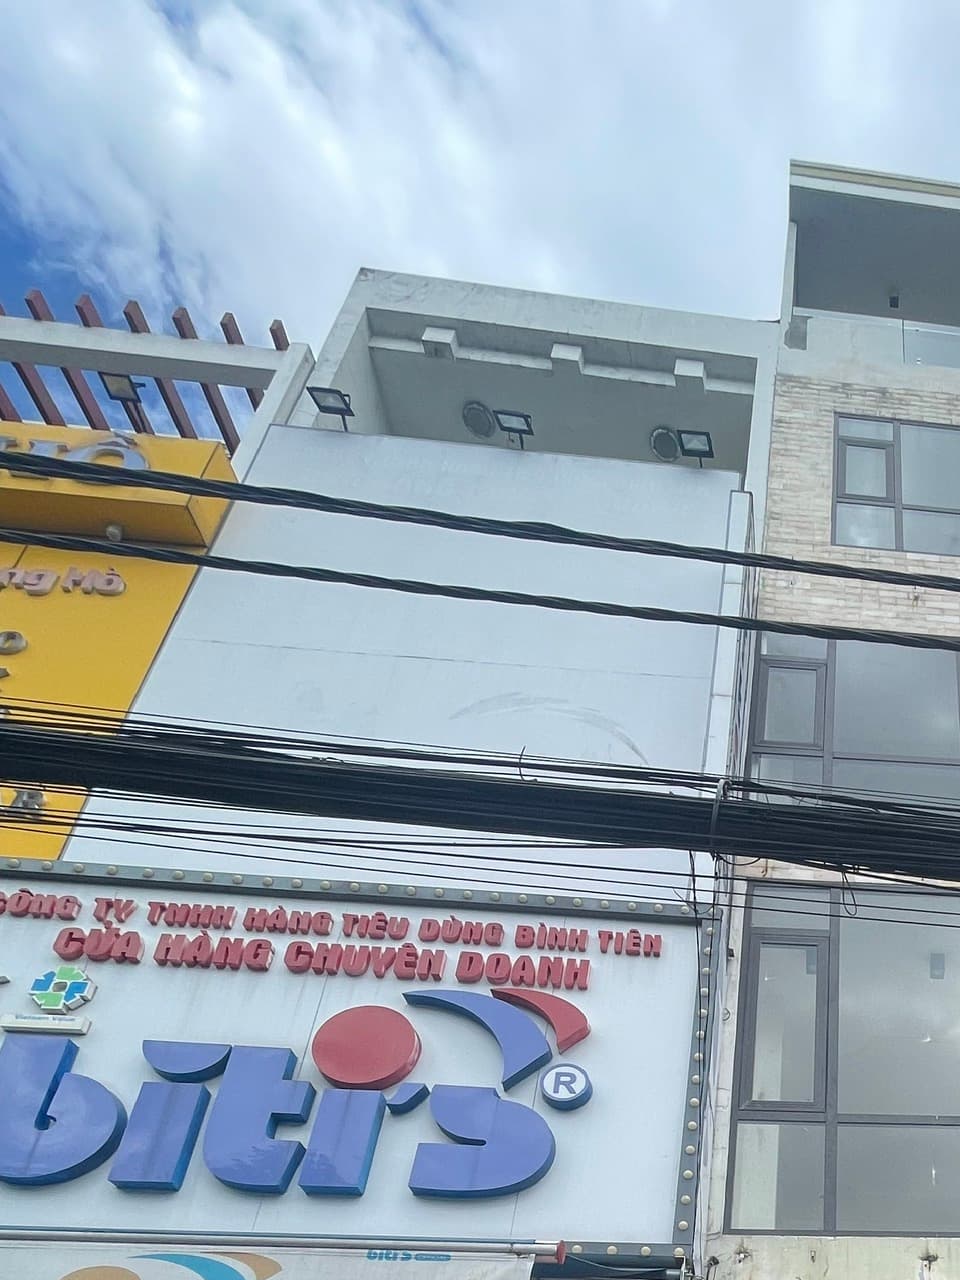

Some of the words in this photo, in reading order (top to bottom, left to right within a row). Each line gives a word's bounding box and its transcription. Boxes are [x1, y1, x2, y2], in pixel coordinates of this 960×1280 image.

[0, 888, 82, 921] ÔNG
[93, 897, 137, 922] TY
[147, 901, 236, 929] TNHH
[243, 905, 334, 936] HÀNG
[342, 912, 409, 940] TIÊU
[418, 915, 504, 946] DÙNG
[515, 922, 588, 952] BÌNH
[597, 928, 662, 957] TIÊN
[53, 920, 143, 964] CỬA
[153, 930, 275, 972] HÀNG
[284, 941, 447, 981] CHUYÊN
[456, 951, 591, 990] DOANH
